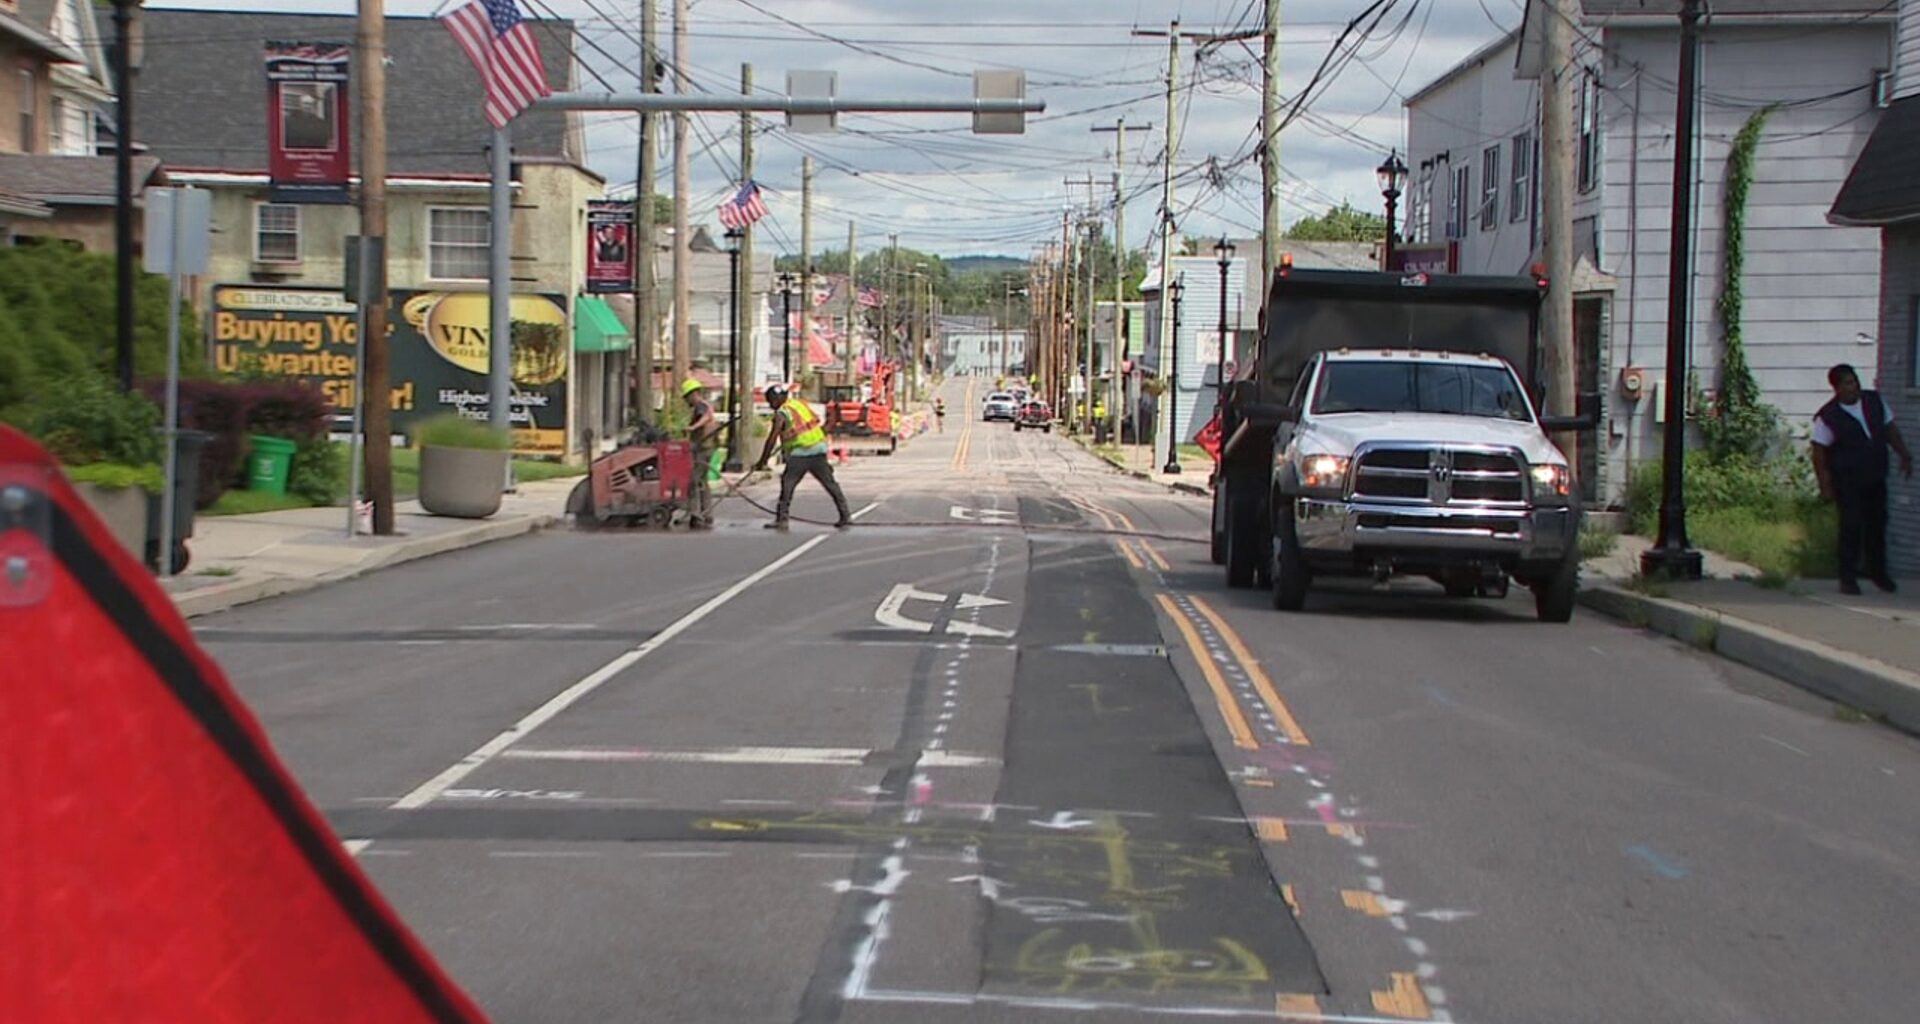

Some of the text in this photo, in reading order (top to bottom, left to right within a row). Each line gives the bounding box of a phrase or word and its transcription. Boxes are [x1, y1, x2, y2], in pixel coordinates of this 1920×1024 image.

[216, 312, 321, 349] Buying
[439, 323, 488, 346] VIN
[215, 345, 357, 375] Uwante
[322, 378, 413, 411] Silr!
[438, 388, 490, 408] Highes
